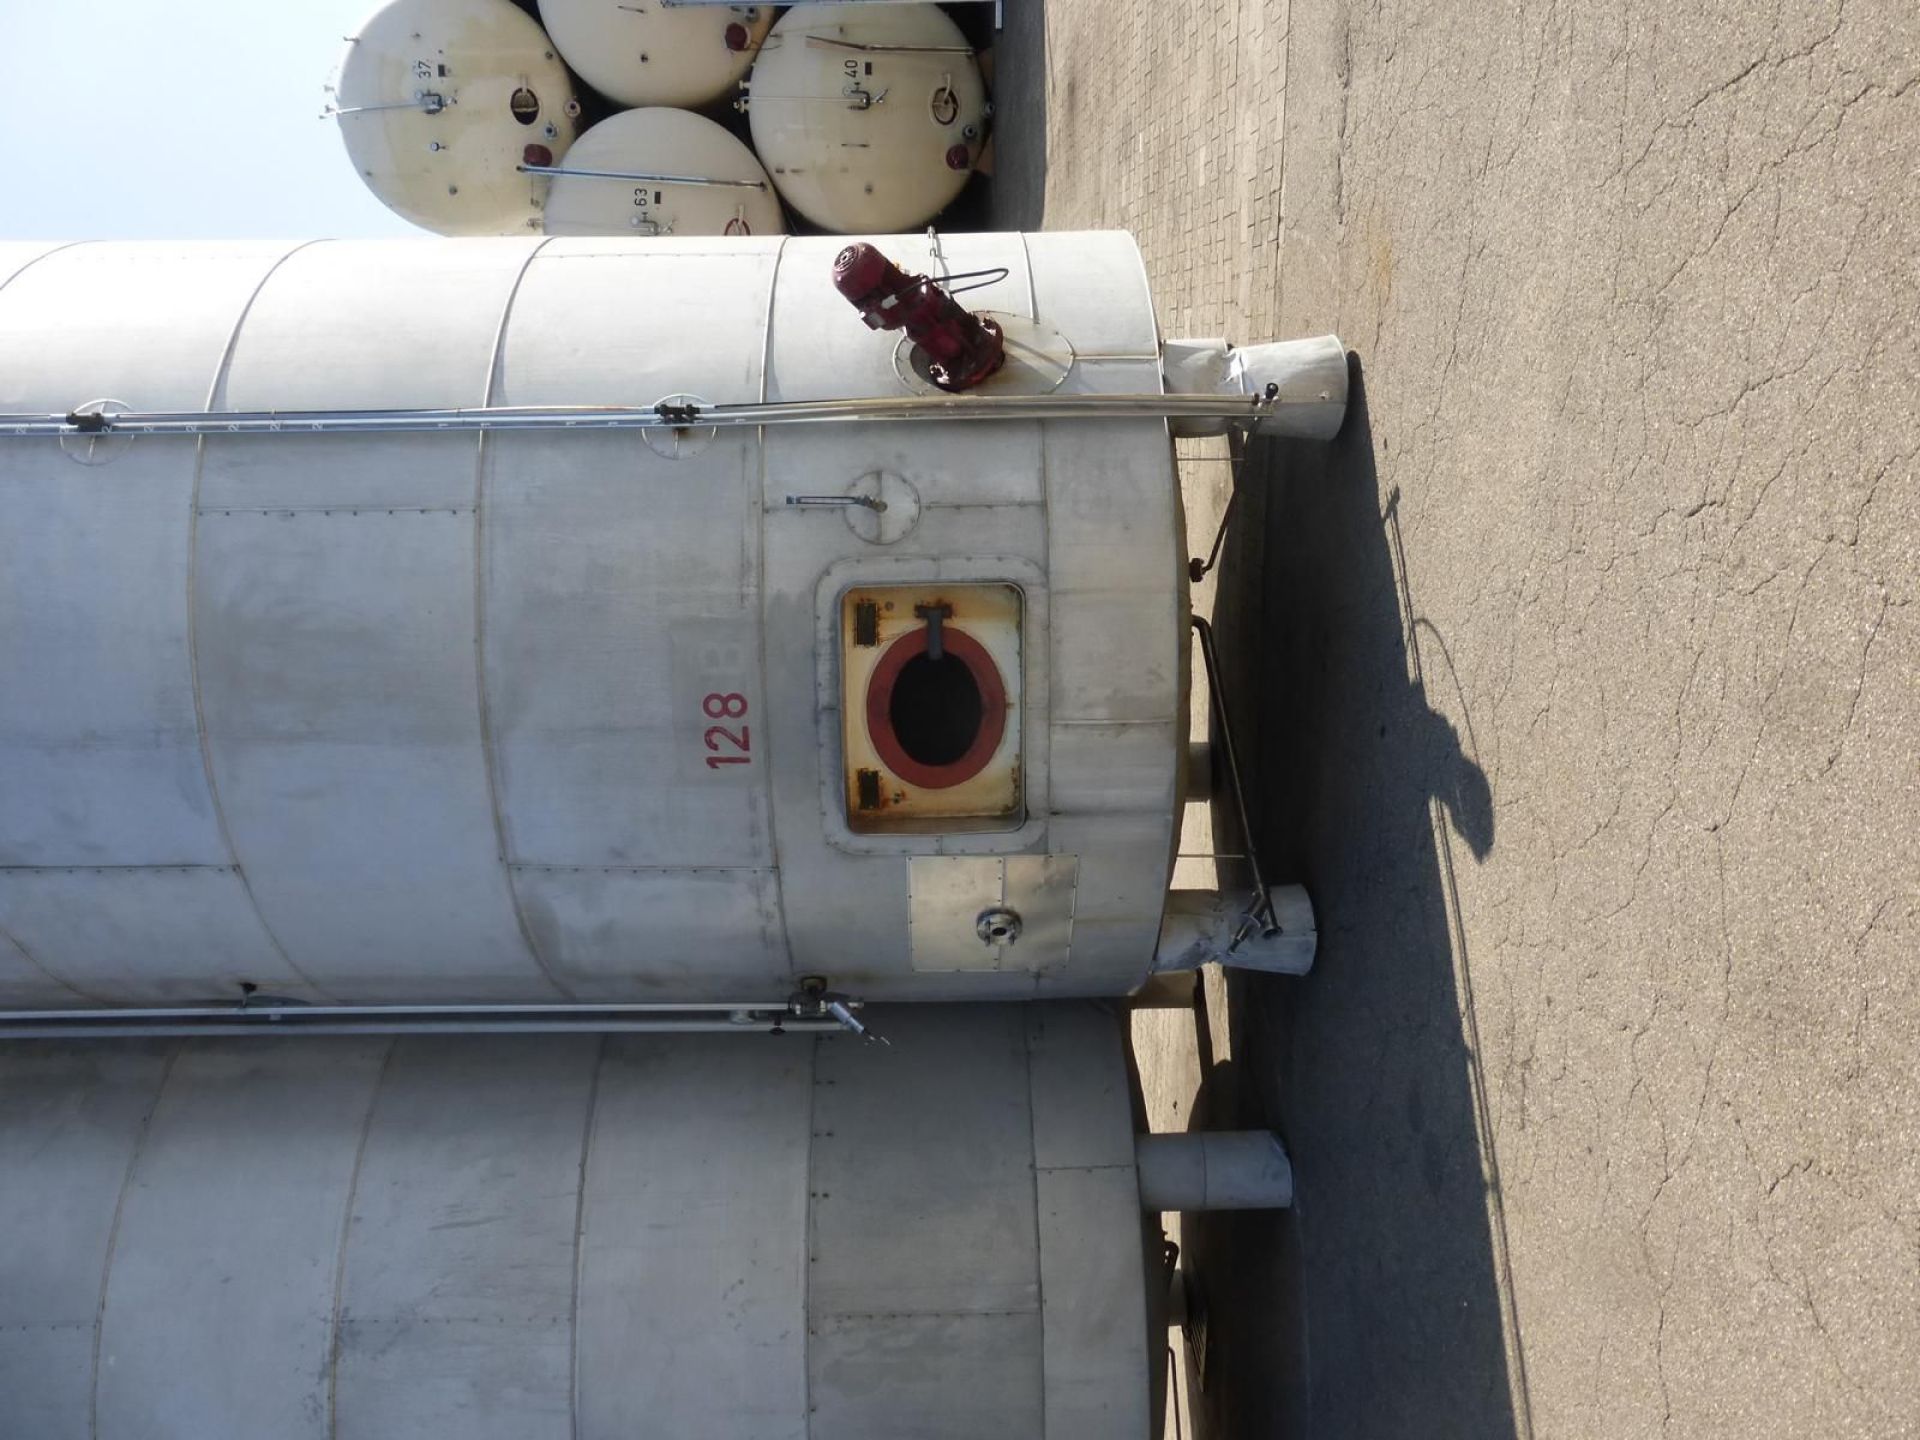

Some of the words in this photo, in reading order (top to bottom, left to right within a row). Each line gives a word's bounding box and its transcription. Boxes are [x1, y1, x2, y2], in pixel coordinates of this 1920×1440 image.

[418, 60, 431, 79] 37
[844, 60, 858, 78] 40
[634, 188, 648, 207] 63
[704, 693, 750, 769] 128
